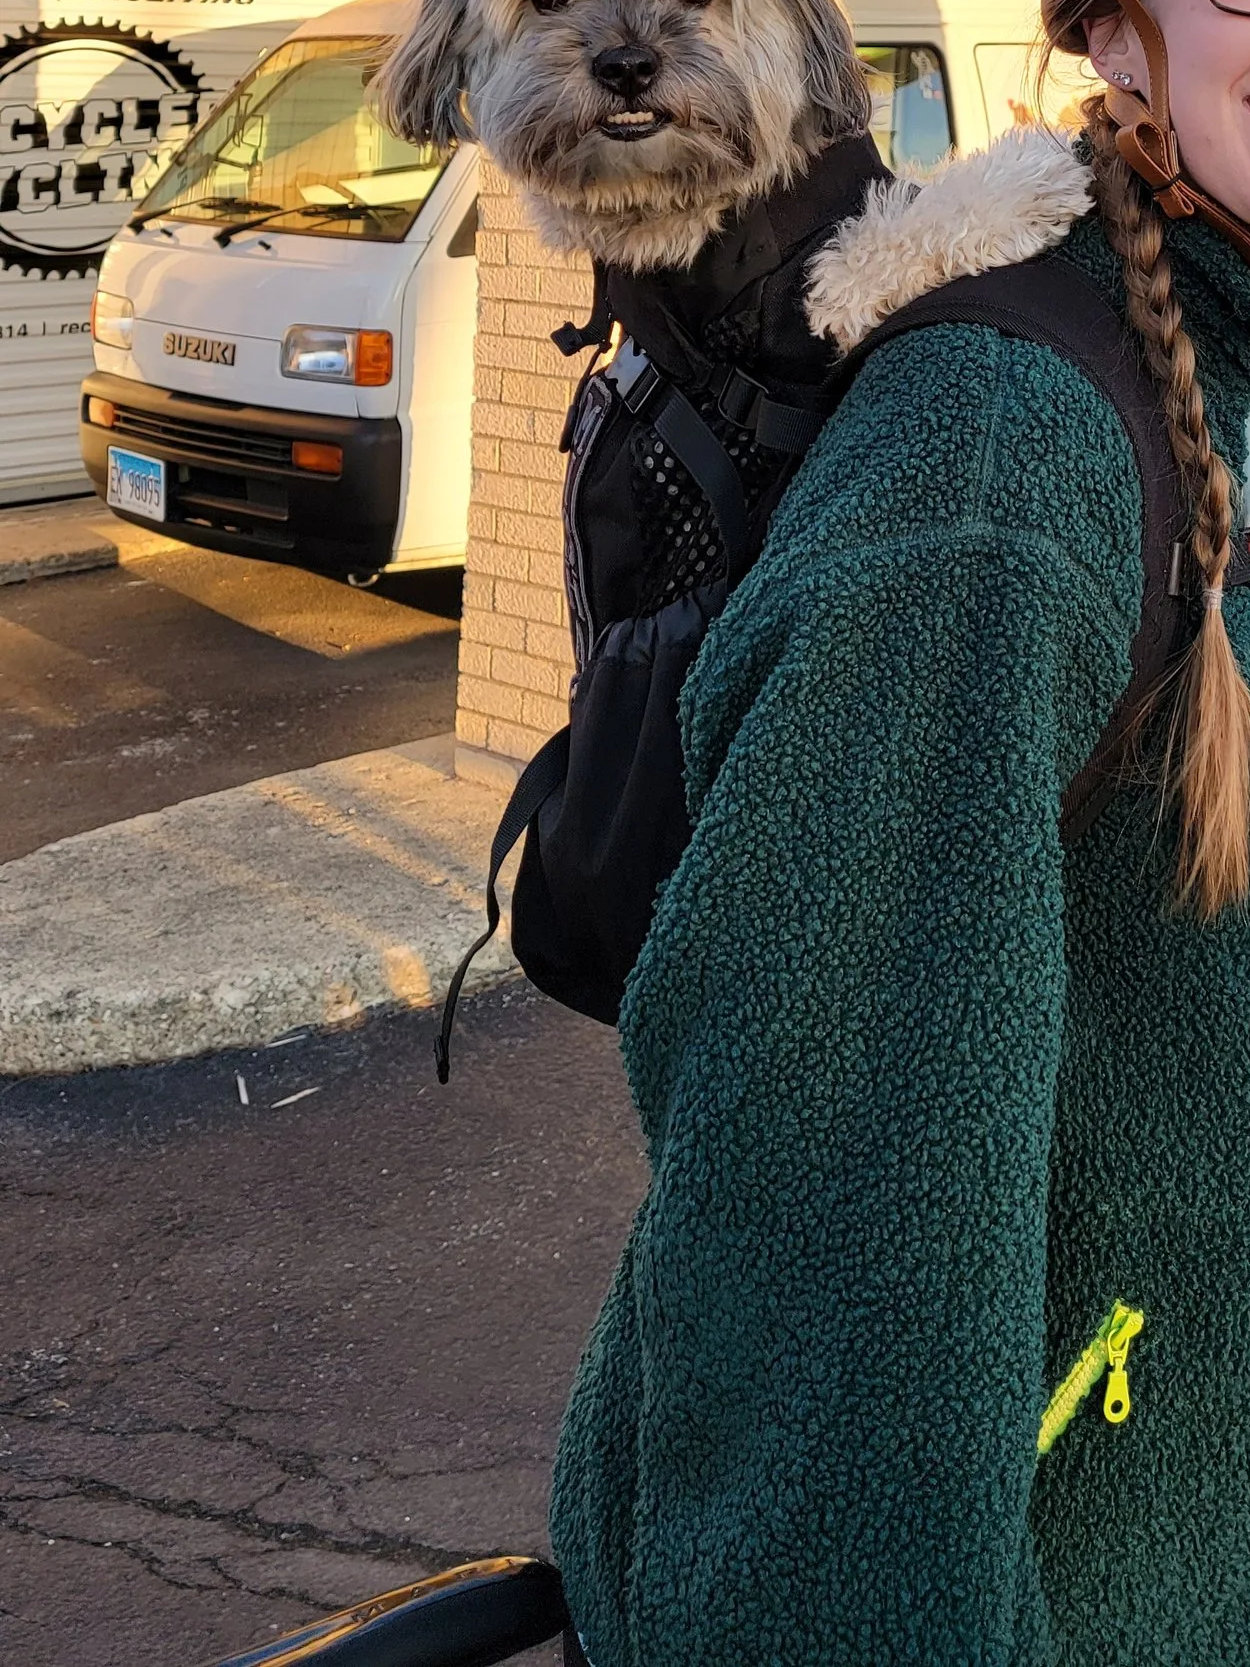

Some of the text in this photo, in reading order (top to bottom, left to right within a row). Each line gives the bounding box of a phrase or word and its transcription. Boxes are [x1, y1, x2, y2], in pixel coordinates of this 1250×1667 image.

[0, 322, 28, 339] 14
[163, 332, 236, 366] SUZUKI
[128, 470, 160, 507] 98095
